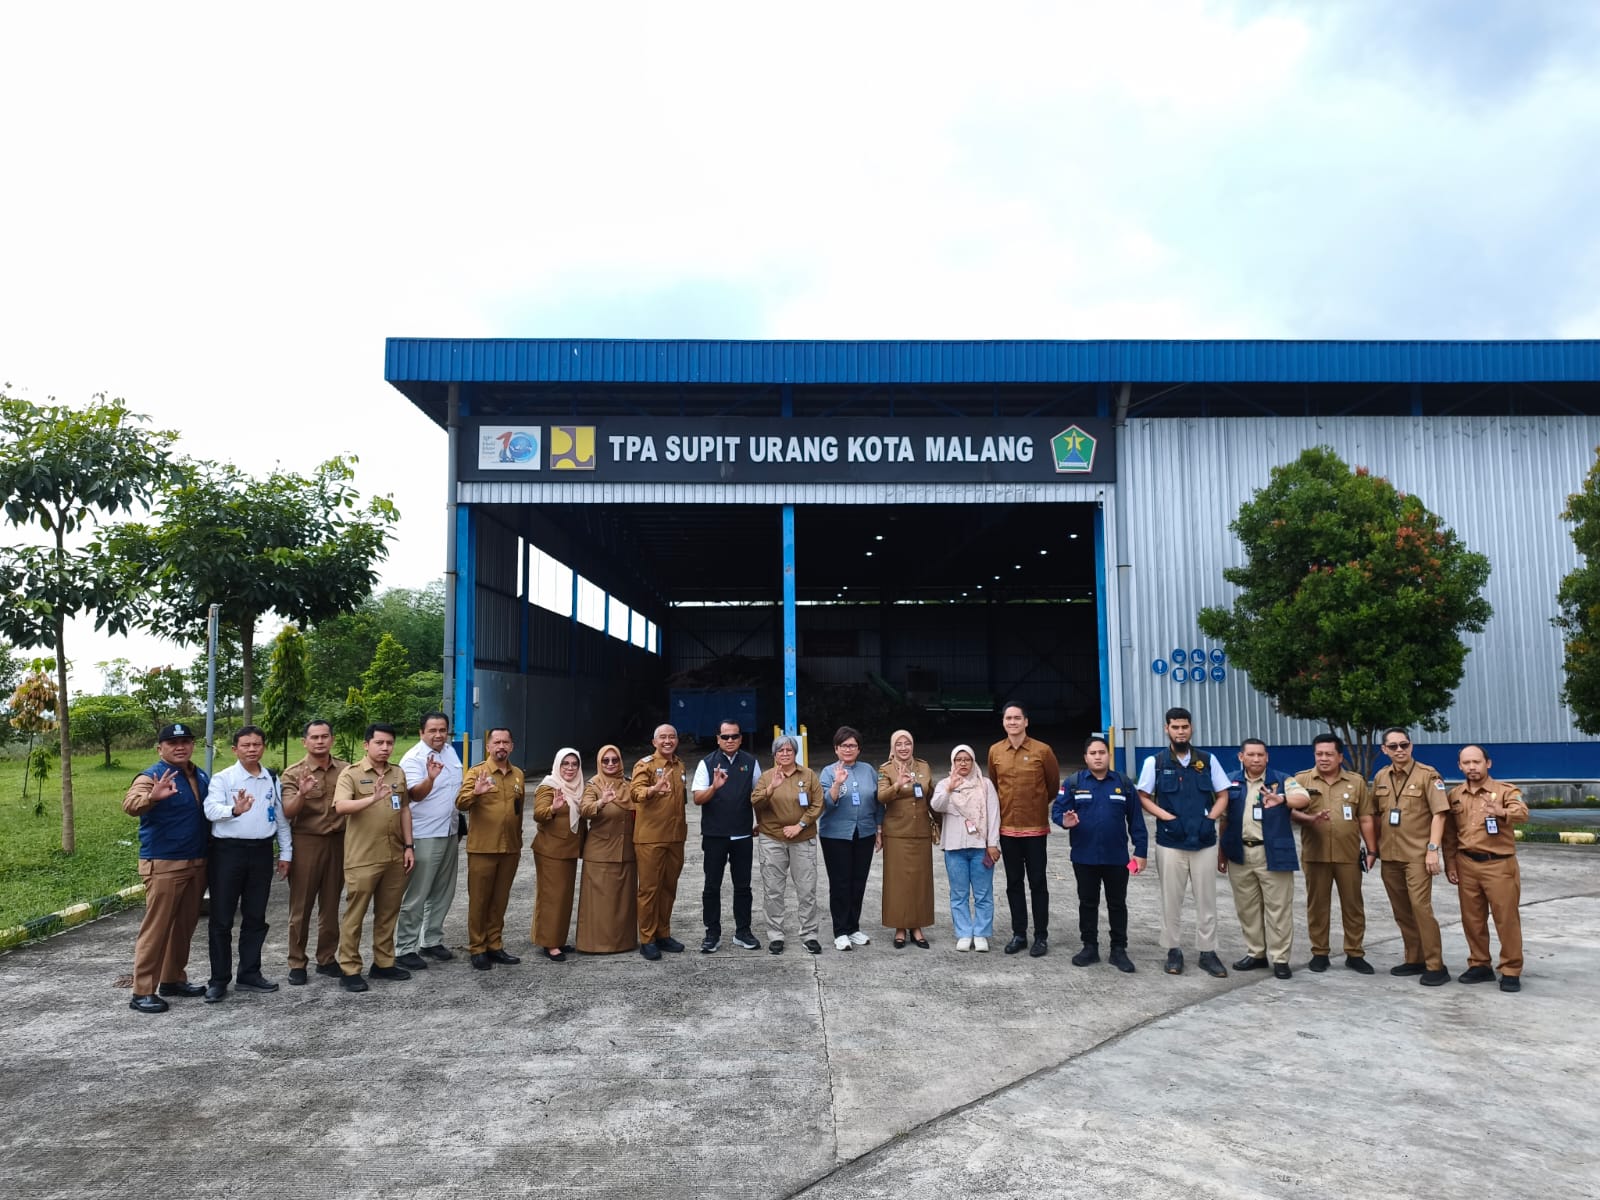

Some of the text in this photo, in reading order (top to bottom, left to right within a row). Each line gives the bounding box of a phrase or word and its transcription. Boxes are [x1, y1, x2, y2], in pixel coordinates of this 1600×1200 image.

[608, 434, 1034, 463] TPA SUPIT URANG KOTA MALANG
